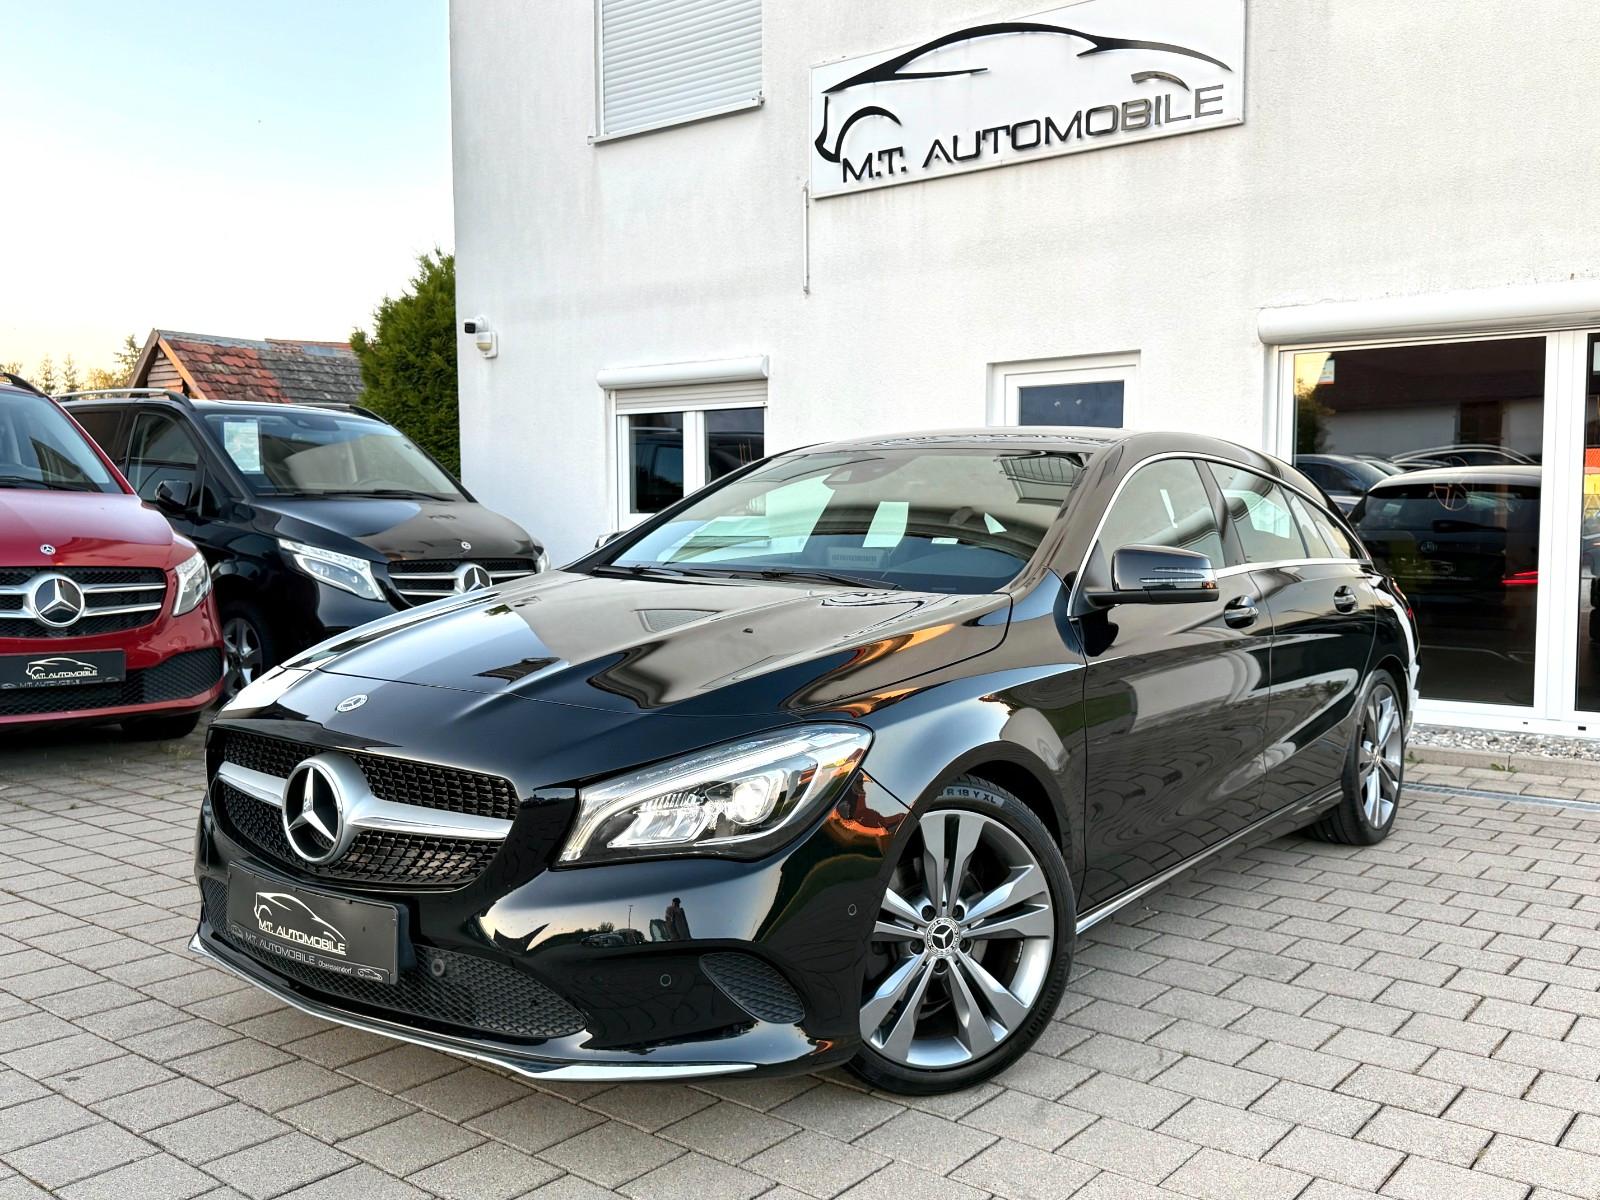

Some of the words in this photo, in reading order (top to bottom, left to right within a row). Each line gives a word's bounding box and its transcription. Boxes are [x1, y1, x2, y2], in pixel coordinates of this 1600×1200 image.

[842, 146, 907, 183] M.T.
[922, 84, 1224, 168] AUTOMOBILE
[48, 669, 98, 678] AUTOMOBILE
[946, 788, 955, 796] R
[957, 788, 969, 797] 18
[973, 790, 980, 798] Y
[983, 793, 997, 804] XL
[276, 925, 346, 953] AUTOMOBILE
[260, 940, 315, 965] AUTOMOBILE
